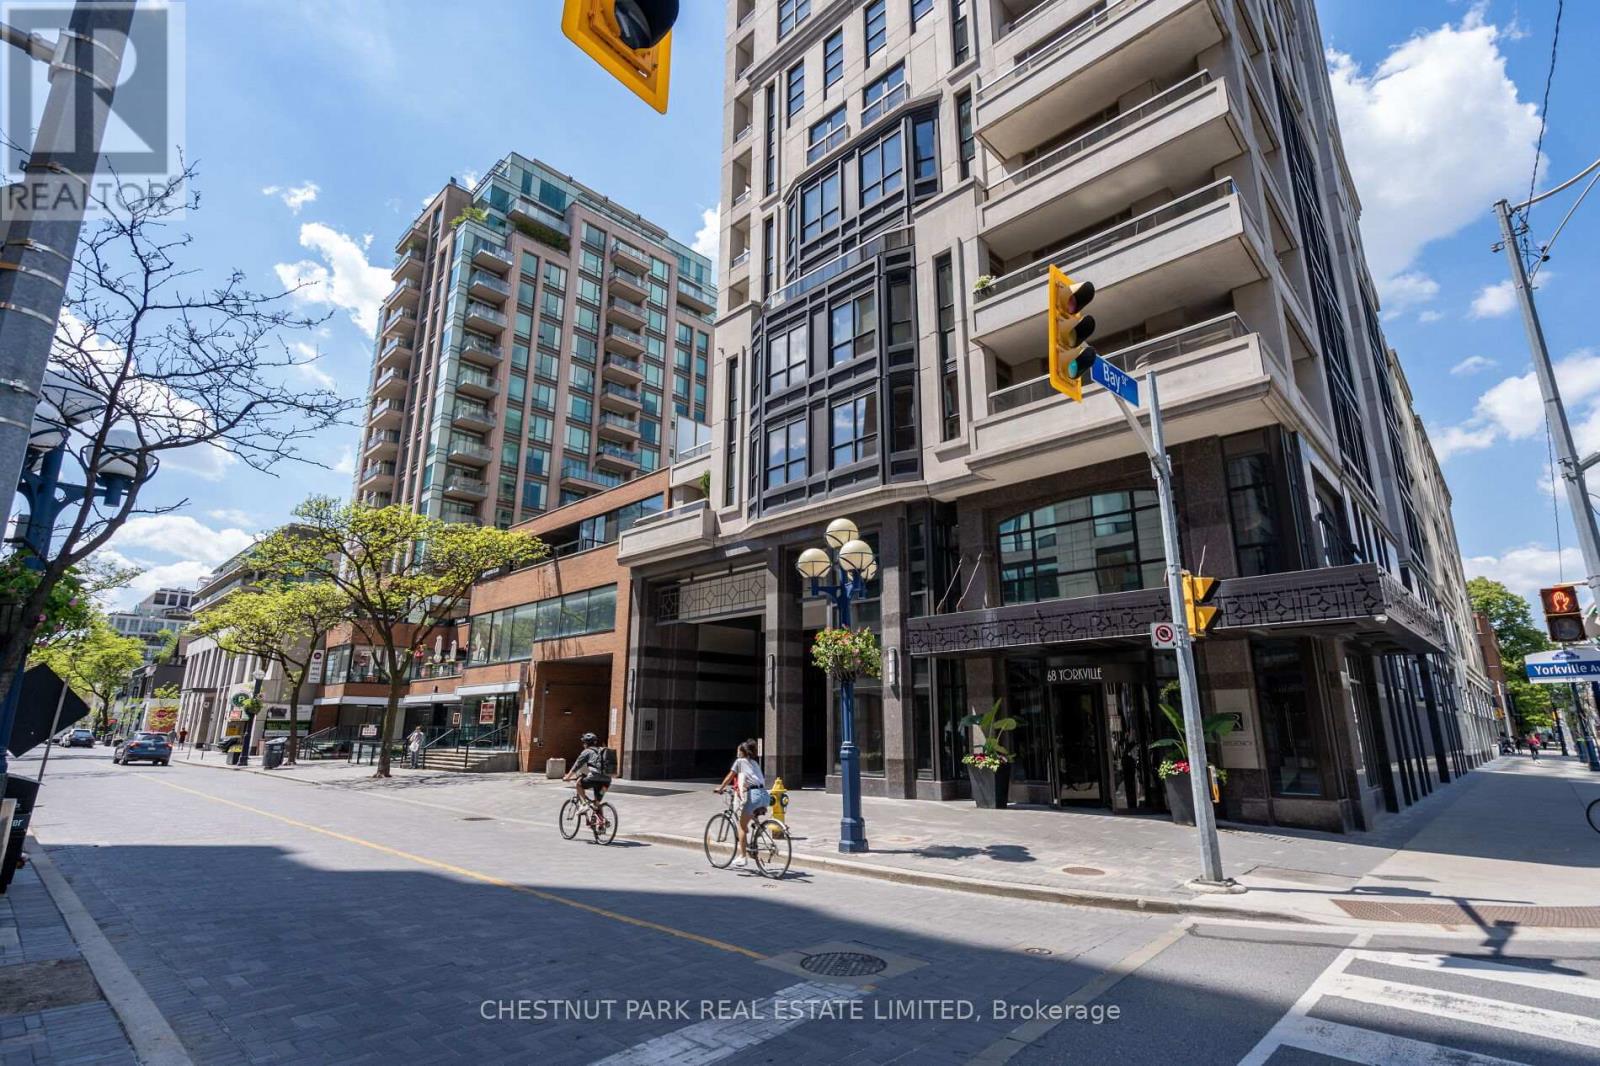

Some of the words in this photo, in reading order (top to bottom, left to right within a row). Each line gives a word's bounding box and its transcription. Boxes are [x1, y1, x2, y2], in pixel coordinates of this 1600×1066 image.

[1103, 362, 1120, 393] Bay
[1047, 669, 1057, 681] 68
[1059, 667, 1102, 680] YORKVILLE
[1534, 664, 1587, 675] Yorkville
